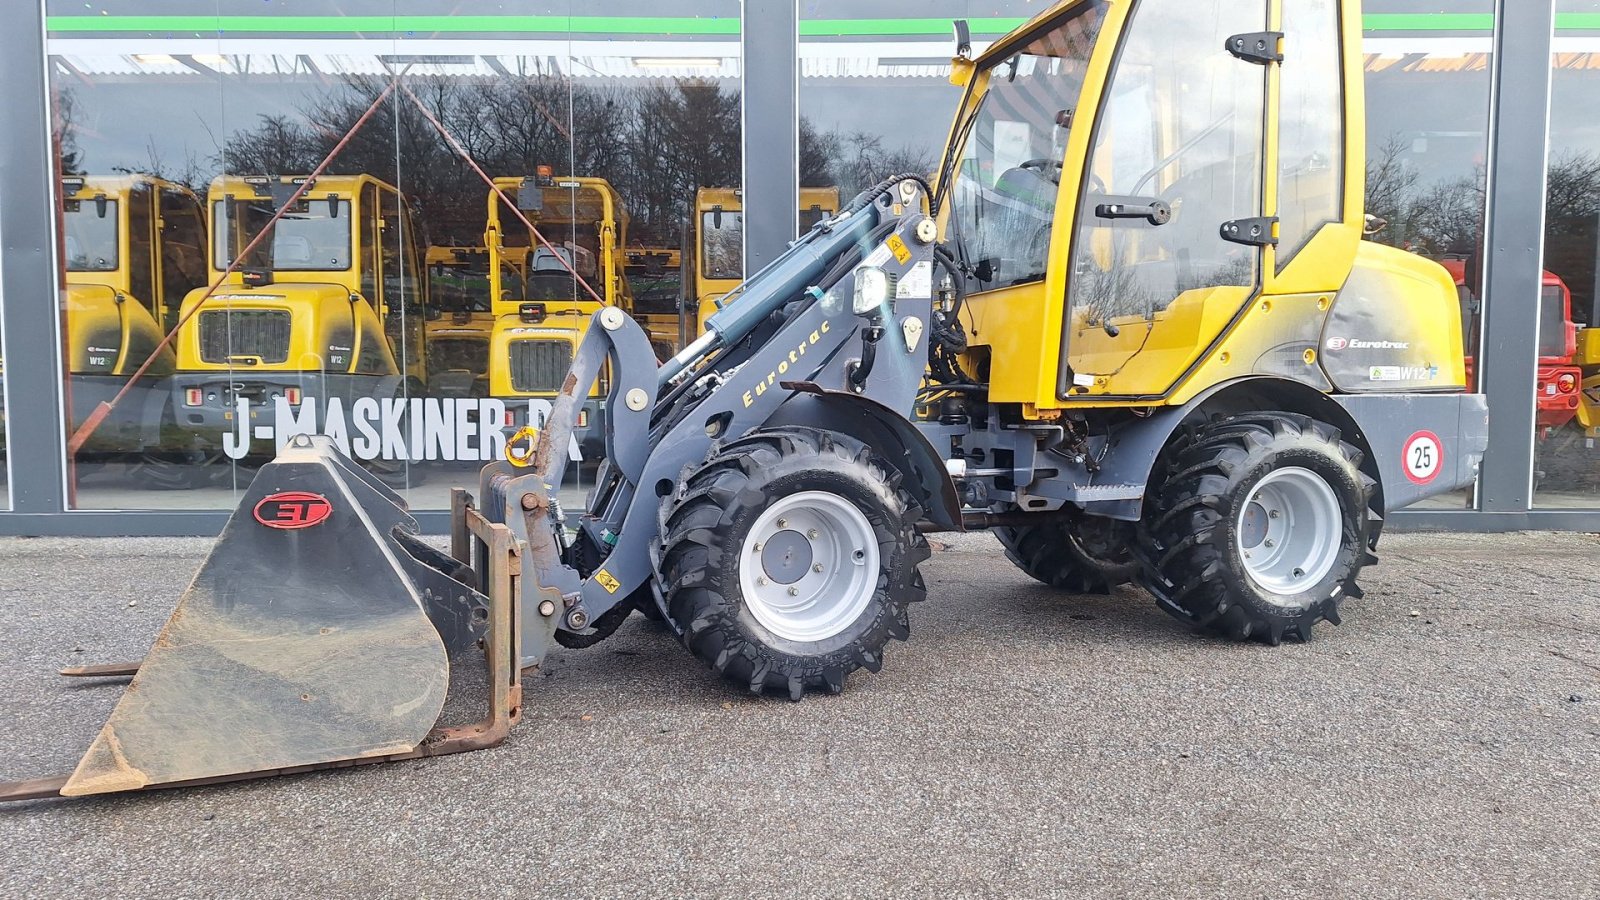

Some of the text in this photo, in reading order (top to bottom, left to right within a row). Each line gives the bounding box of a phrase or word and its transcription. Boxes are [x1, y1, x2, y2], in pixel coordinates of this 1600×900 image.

[1349, 338, 1409, 349] Eurotrac
[742, 320, 830, 409] Eurotrac
[1414, 446, 1431, 469] 25
